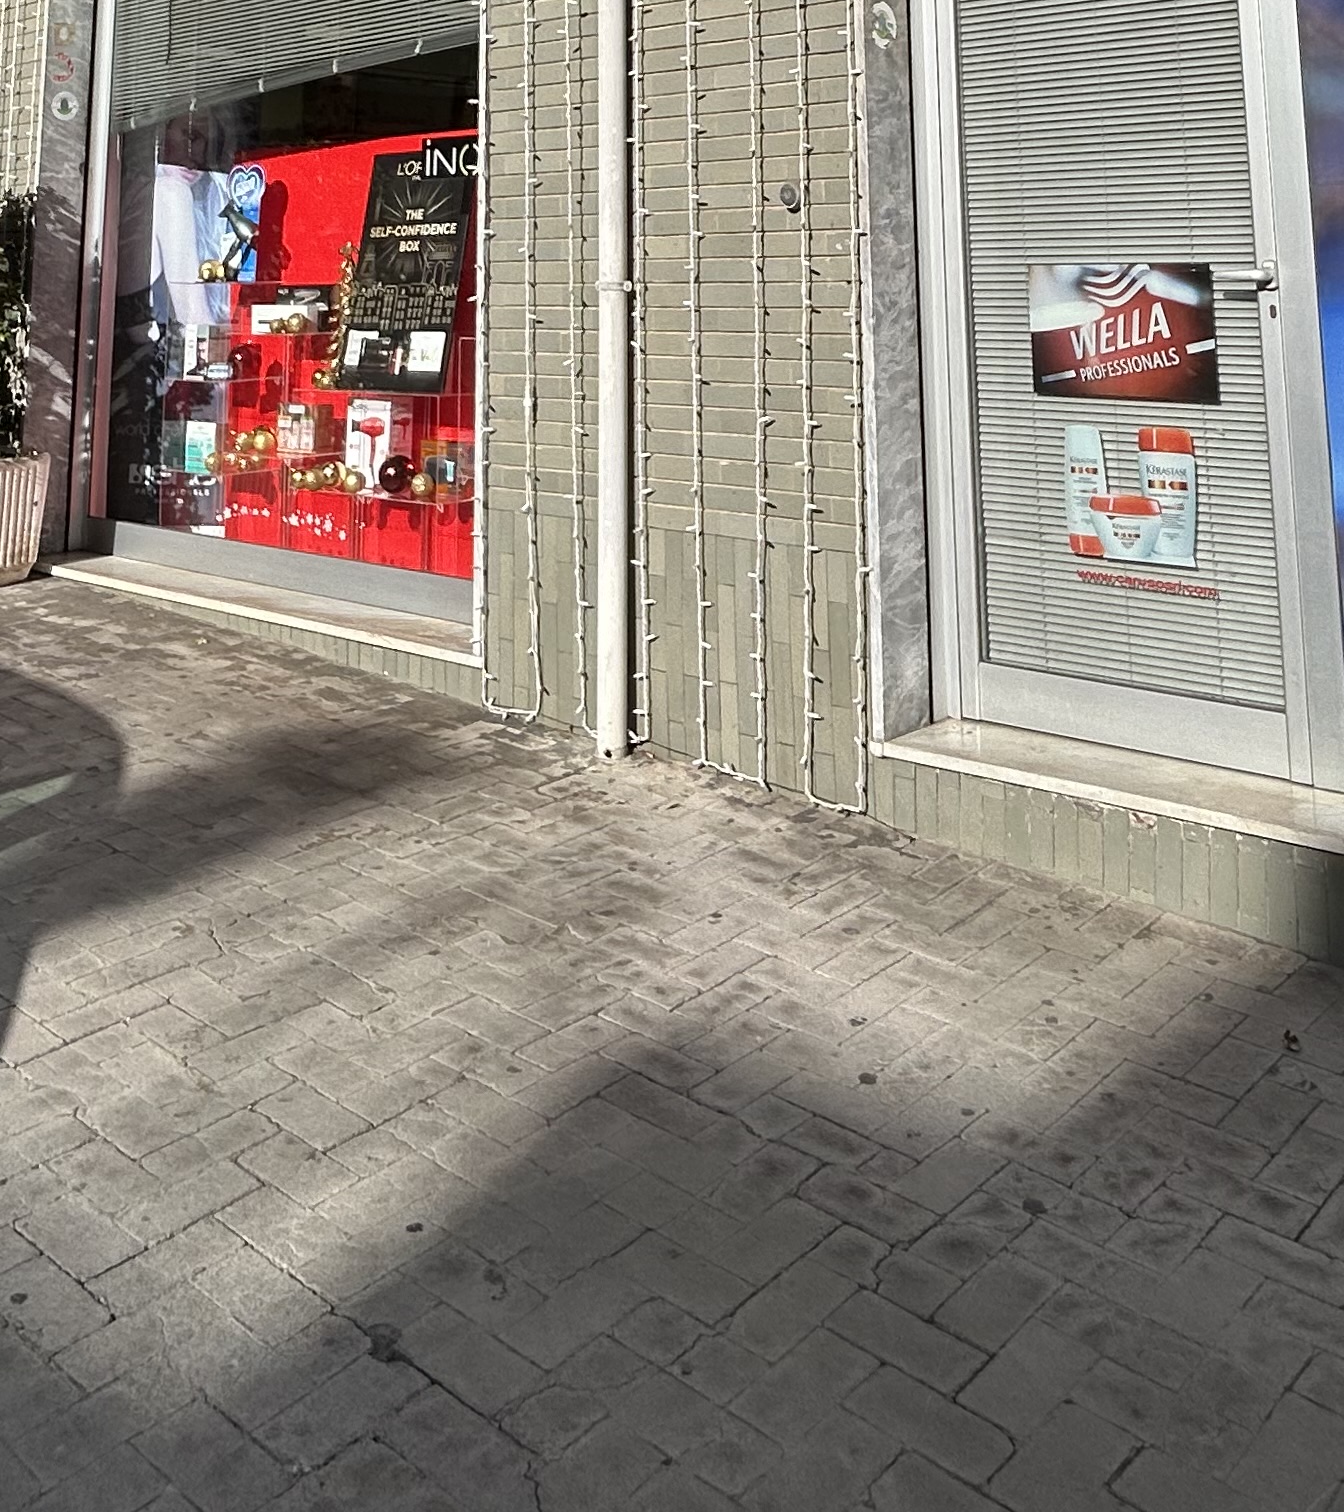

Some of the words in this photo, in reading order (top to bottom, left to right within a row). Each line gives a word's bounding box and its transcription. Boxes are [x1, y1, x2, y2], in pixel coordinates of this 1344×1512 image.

[405, 209, 425, 220] THE
[369, 222, 457, 239] SELF-CONFIDENCE
[398, 240, 420, 252] BOX
[1070, 301, 1171, 360] WELLA
[1079, 347, 1180, 383] PROFESSIONALS
